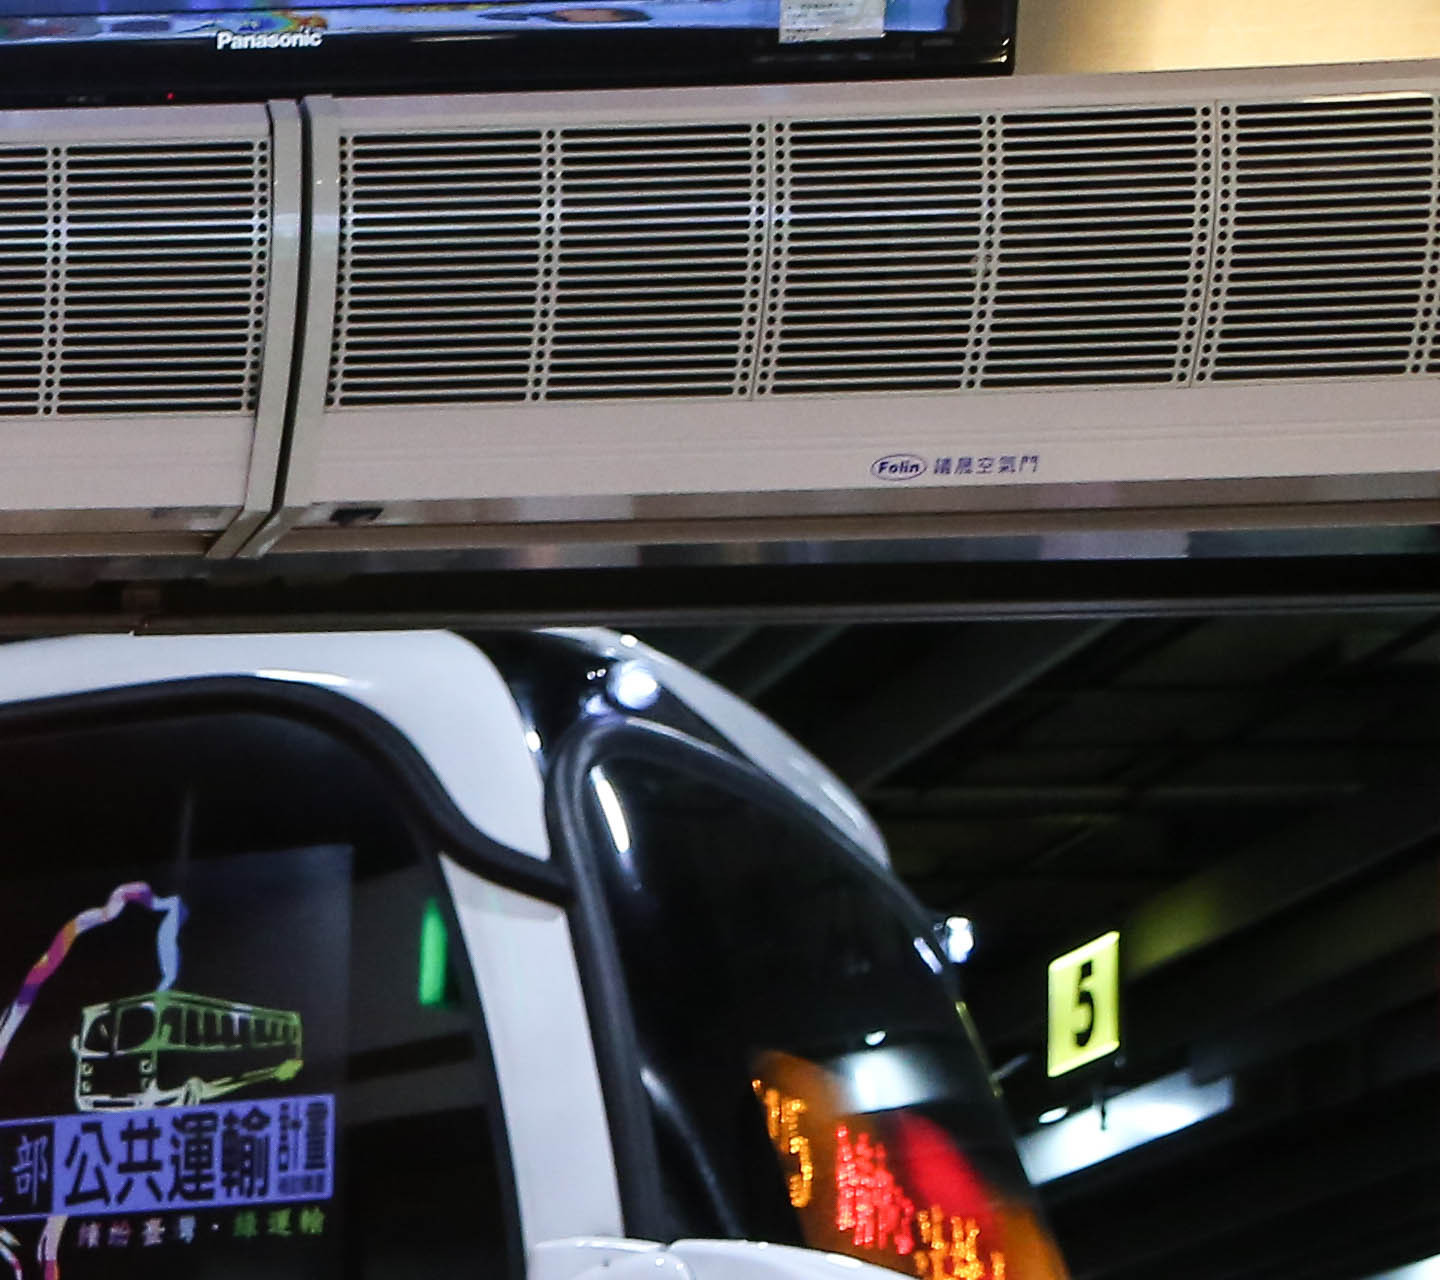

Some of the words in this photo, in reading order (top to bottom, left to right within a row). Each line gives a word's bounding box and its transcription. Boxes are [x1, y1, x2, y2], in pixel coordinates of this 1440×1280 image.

[217, 27, 323, 50] Panasonic
[878, 461, 920, 474] Folin
[1073, 960, 1094, 1048] 5
